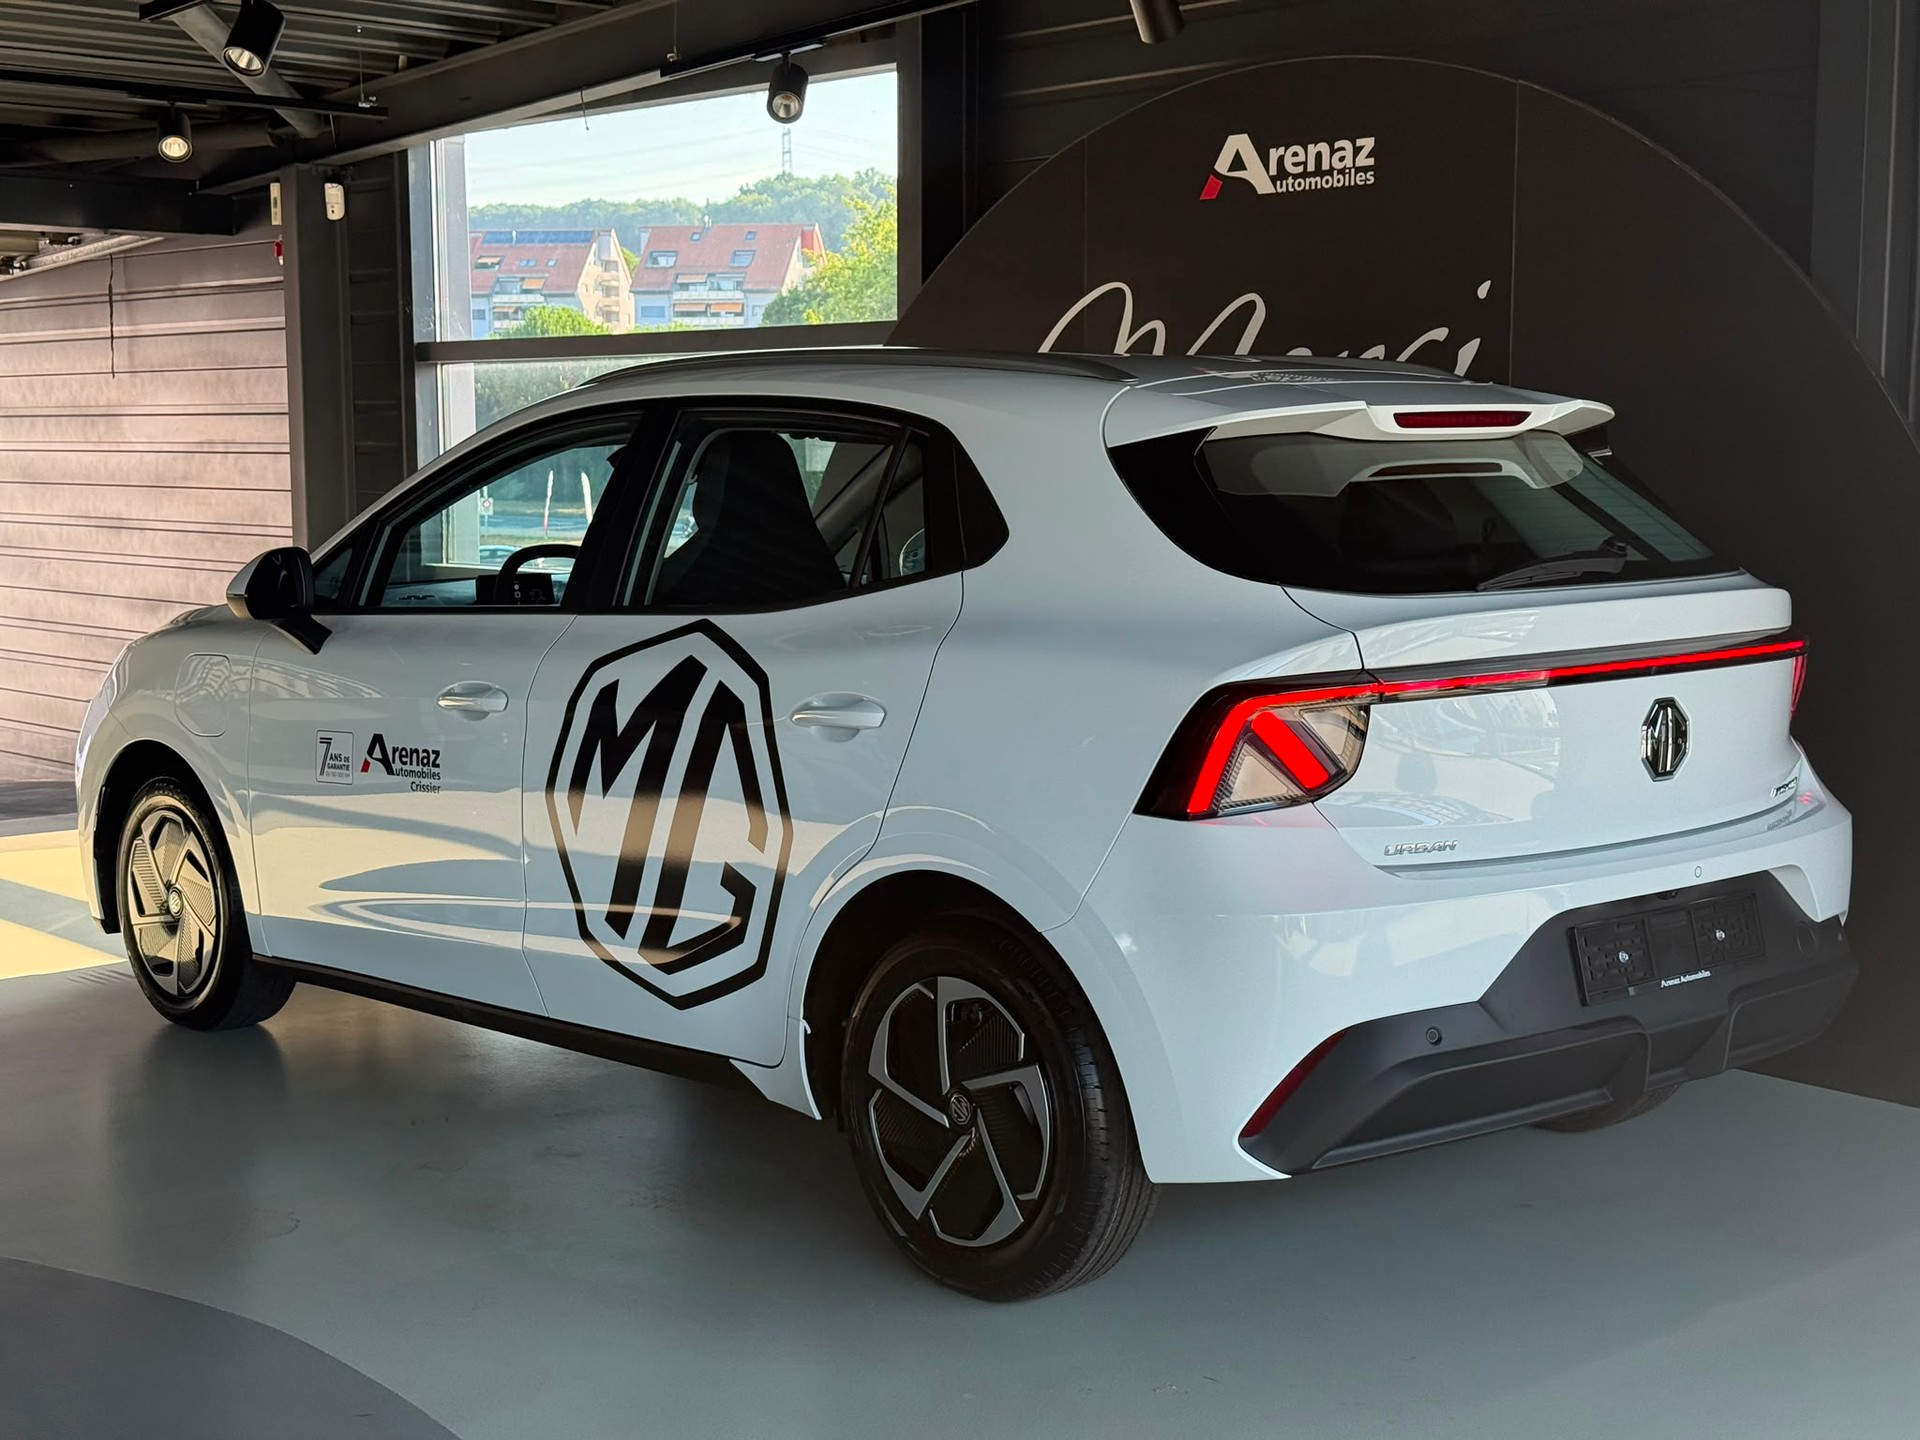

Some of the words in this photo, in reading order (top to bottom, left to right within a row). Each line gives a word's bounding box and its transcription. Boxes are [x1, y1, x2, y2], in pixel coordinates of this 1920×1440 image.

[1200, 133, 1375, 200] Arenaz
[319, 736, 333, 776] 7
[329, 752, 342, 763] ANS
[360, 733, 441, 776] Arenaz
[410, 780, 441, 794] Crissier
[567, 654, 768, 976] MG
[1384, 839, 1459, 857] URBAN
